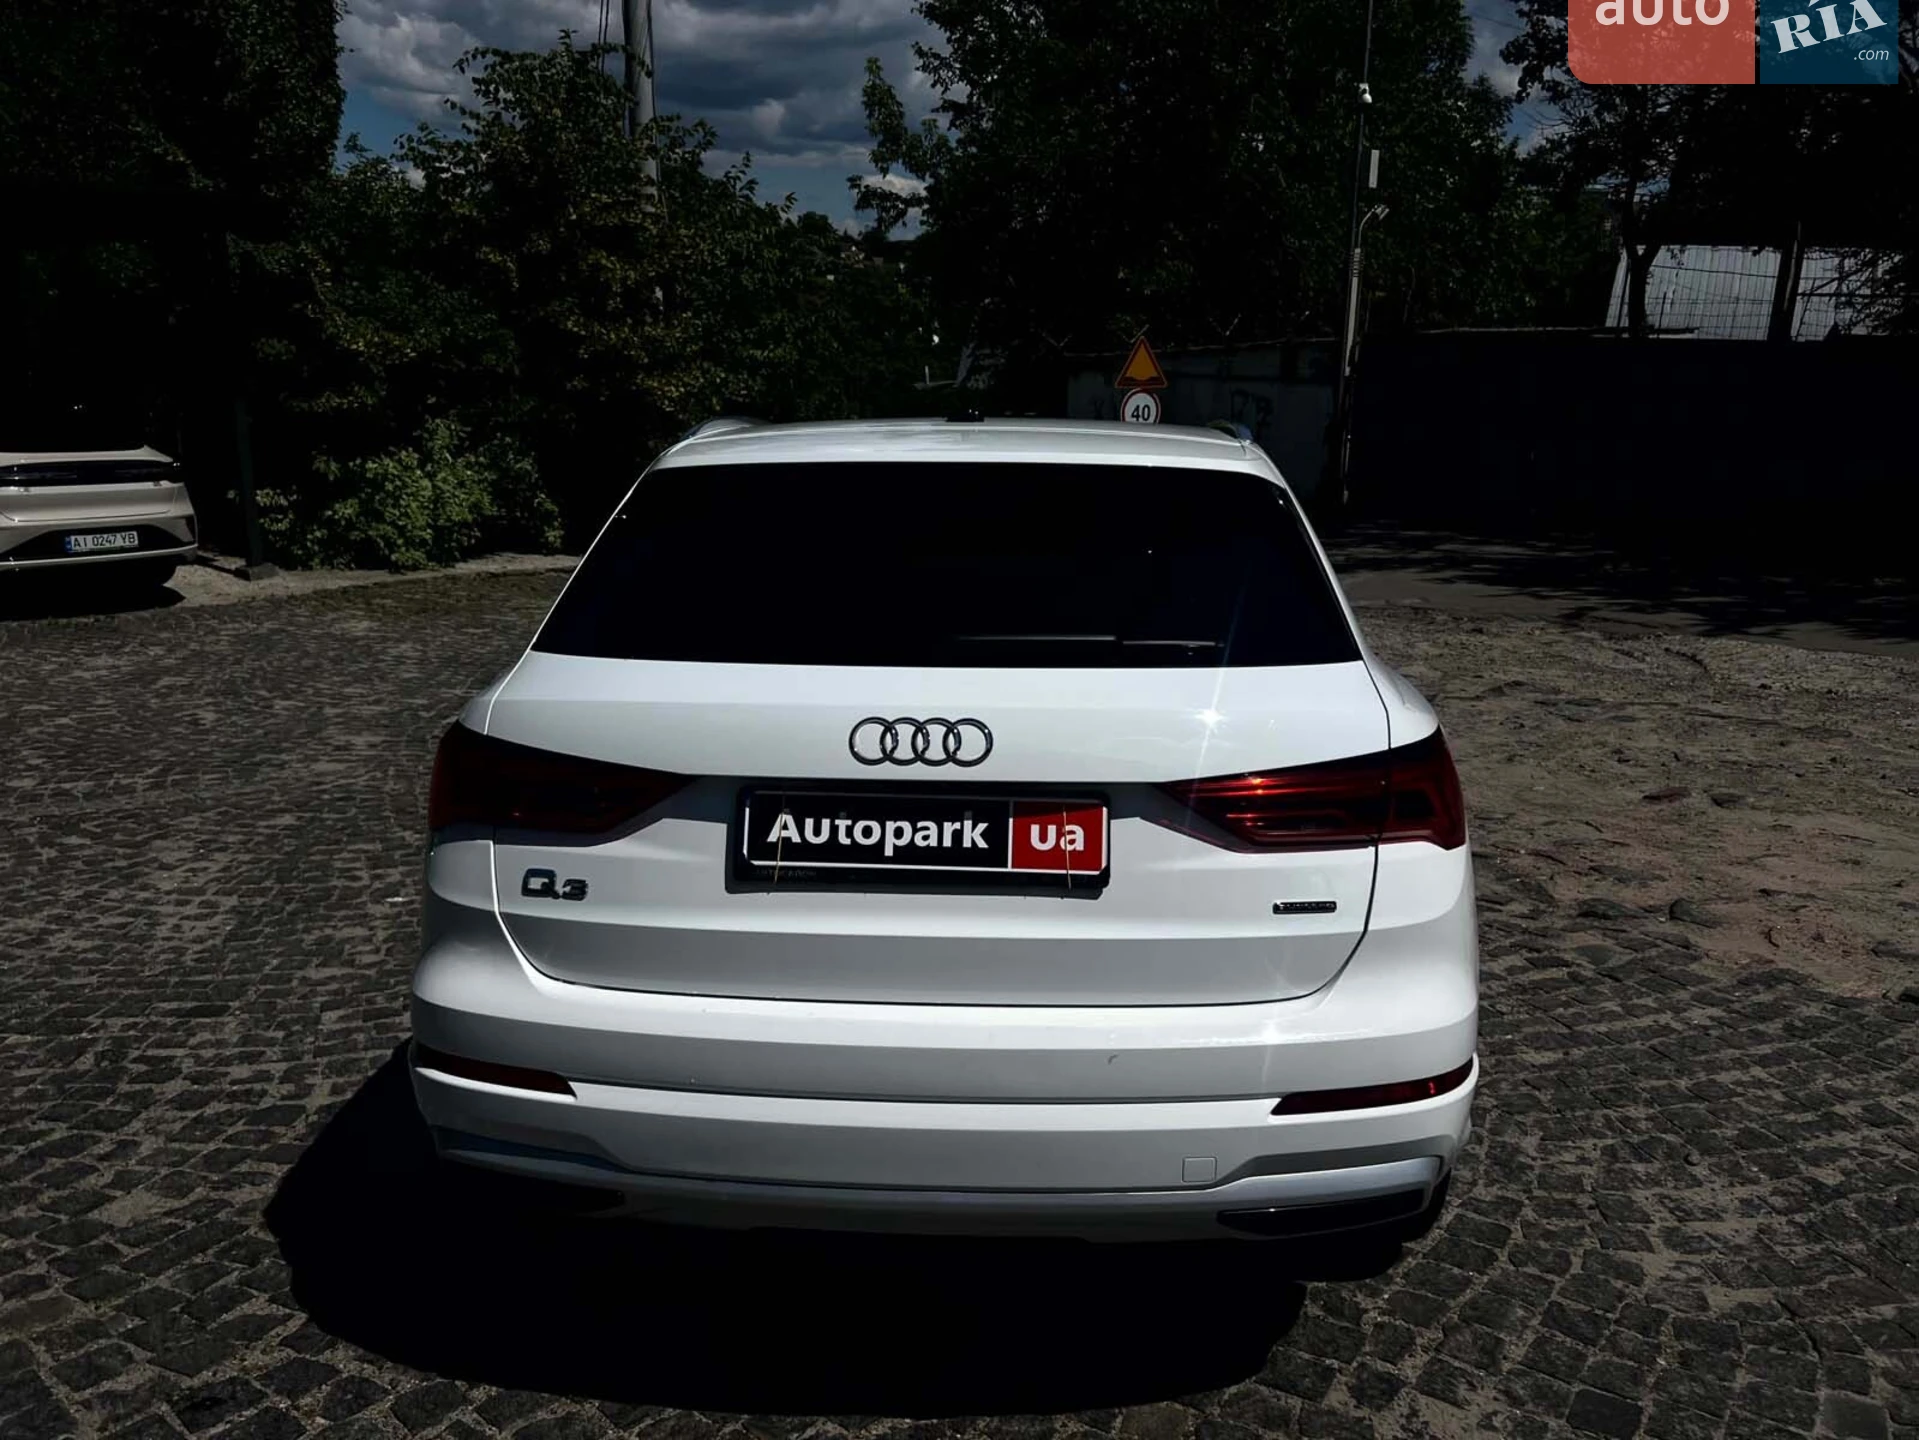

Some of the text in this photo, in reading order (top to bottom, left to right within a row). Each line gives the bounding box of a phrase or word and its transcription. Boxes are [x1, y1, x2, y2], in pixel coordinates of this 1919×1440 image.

[1131, 404, 1151, 421] 40
[91, 534, 117, 548] 0247
[766, 809, 1085, 858] Autopark ua
[521, 867, 589, 902] Q3
